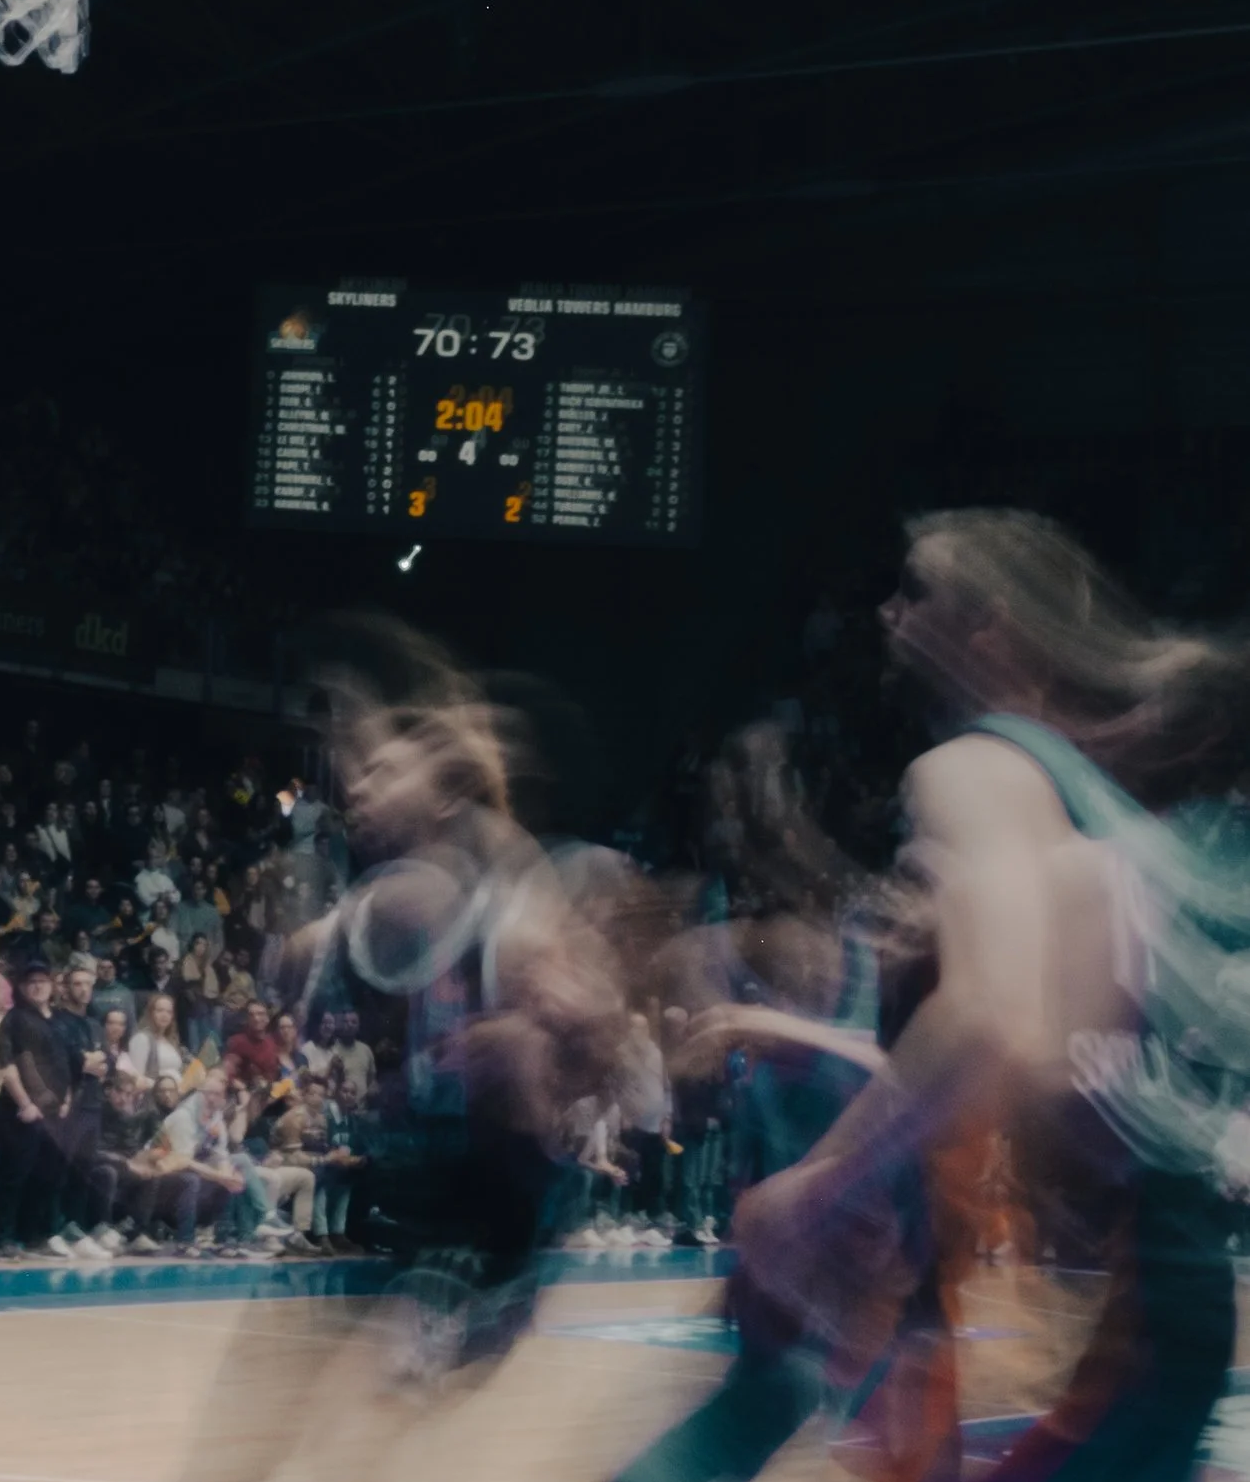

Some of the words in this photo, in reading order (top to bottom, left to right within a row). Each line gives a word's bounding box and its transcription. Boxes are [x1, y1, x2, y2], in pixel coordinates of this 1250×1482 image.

[327, 291, 397, 307] SKYLINERS
[507, 297, 553, 313] VEOLIA
[556, 299, 610, 315] TOWERS
[613, 301, 681, 318] HAMBURG
[434, 398, 504, 433] 2:04
[458, 439, 477, 466] 4
[408, 489, 427, 518] 3
[503, 494, 523, 523] 2
[75, 612, 131, 657] dkd
